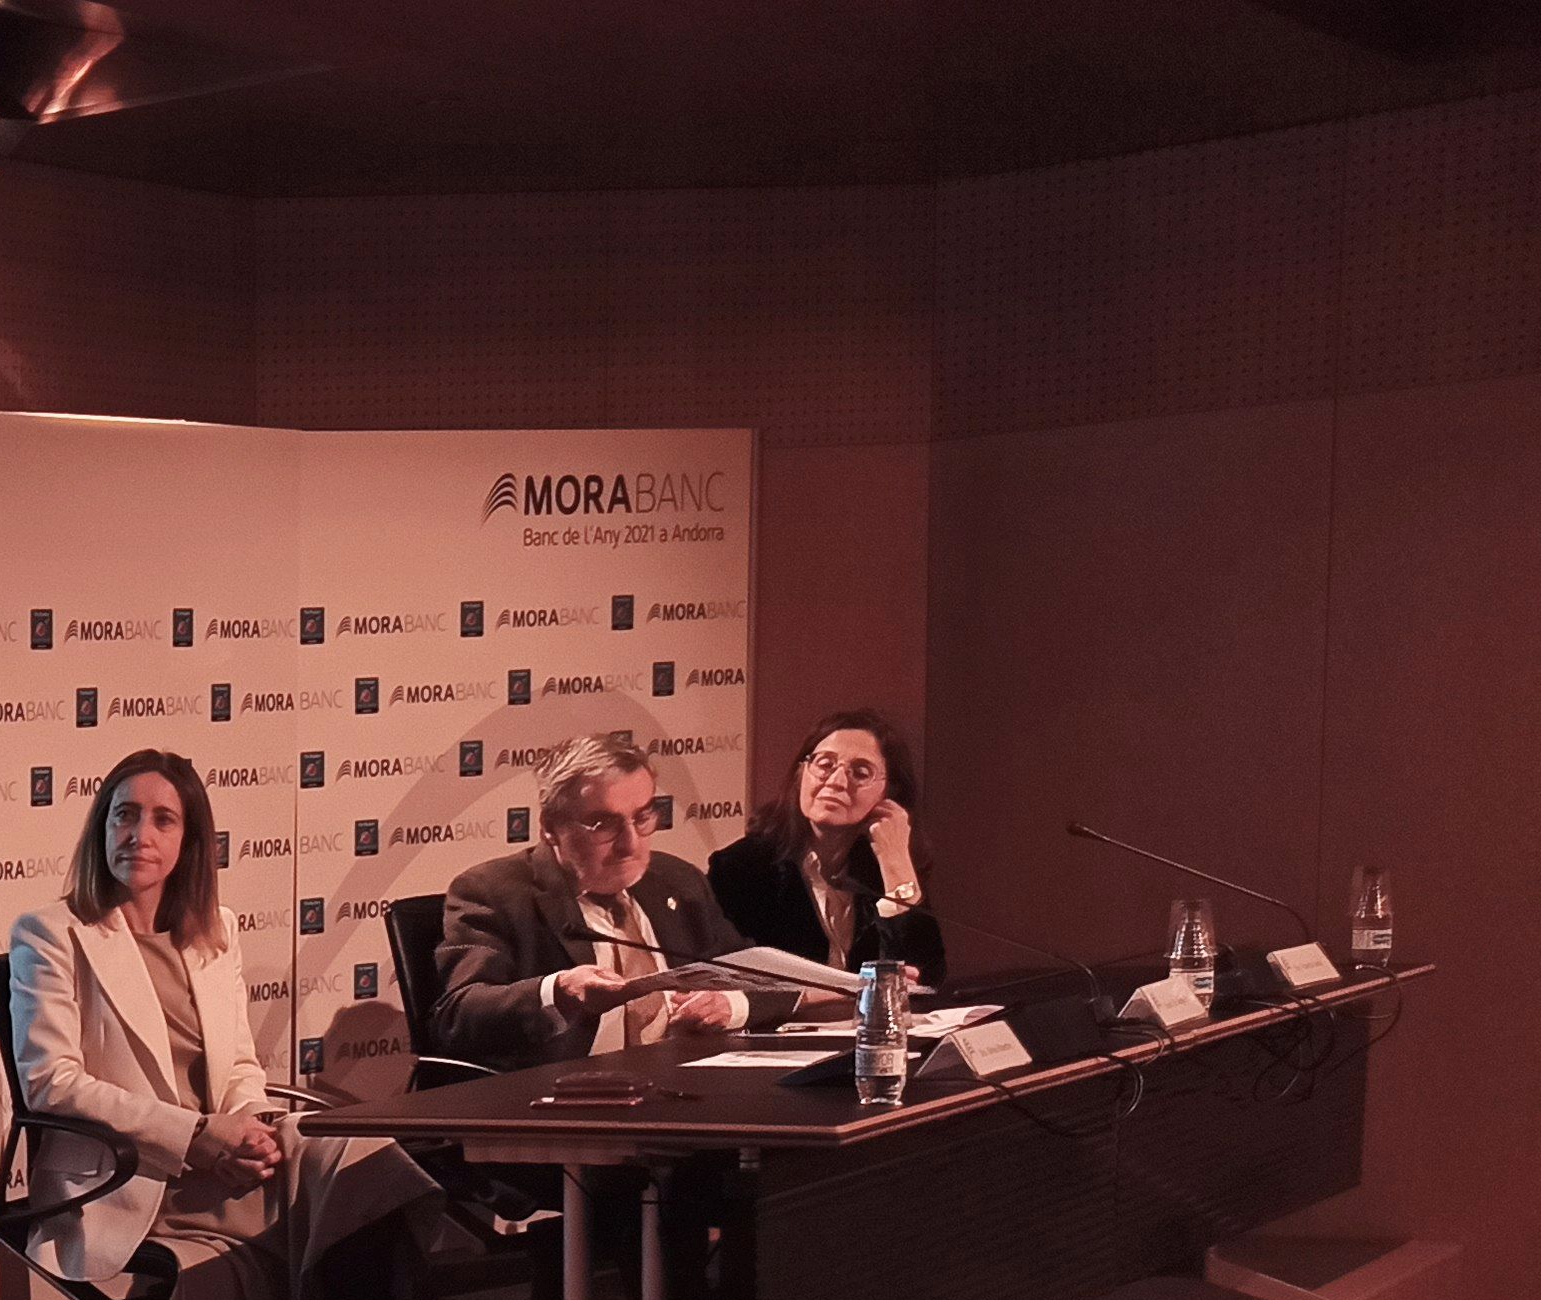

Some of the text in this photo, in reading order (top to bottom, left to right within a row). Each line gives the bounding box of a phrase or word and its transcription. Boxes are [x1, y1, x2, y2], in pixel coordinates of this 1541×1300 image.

[523, 472, 725, 516] MORABANC
[523, 523, 724, 550] Banc de l'Any 2021 a Andorra
[79, 619, 163, 641] MORABANC
[219, 618, 296, 640] MORABANC
[354, 612, 447, 636] MORABANC
[512, 606, 600, 630] MORABANC
[558, 671, 645, 696] MORABANC
[701, 668, 745, 687] MORA
[406, 681, 498, 705] MORABANC
[122, 694, 203, 718] MORABANC
[218, 764, 294, 788] MORABANC
[353, 754, 447, 779] MORABANC
[700, 801, 743, 820] MORA
[406, 819, 497, 847] MORABANC
